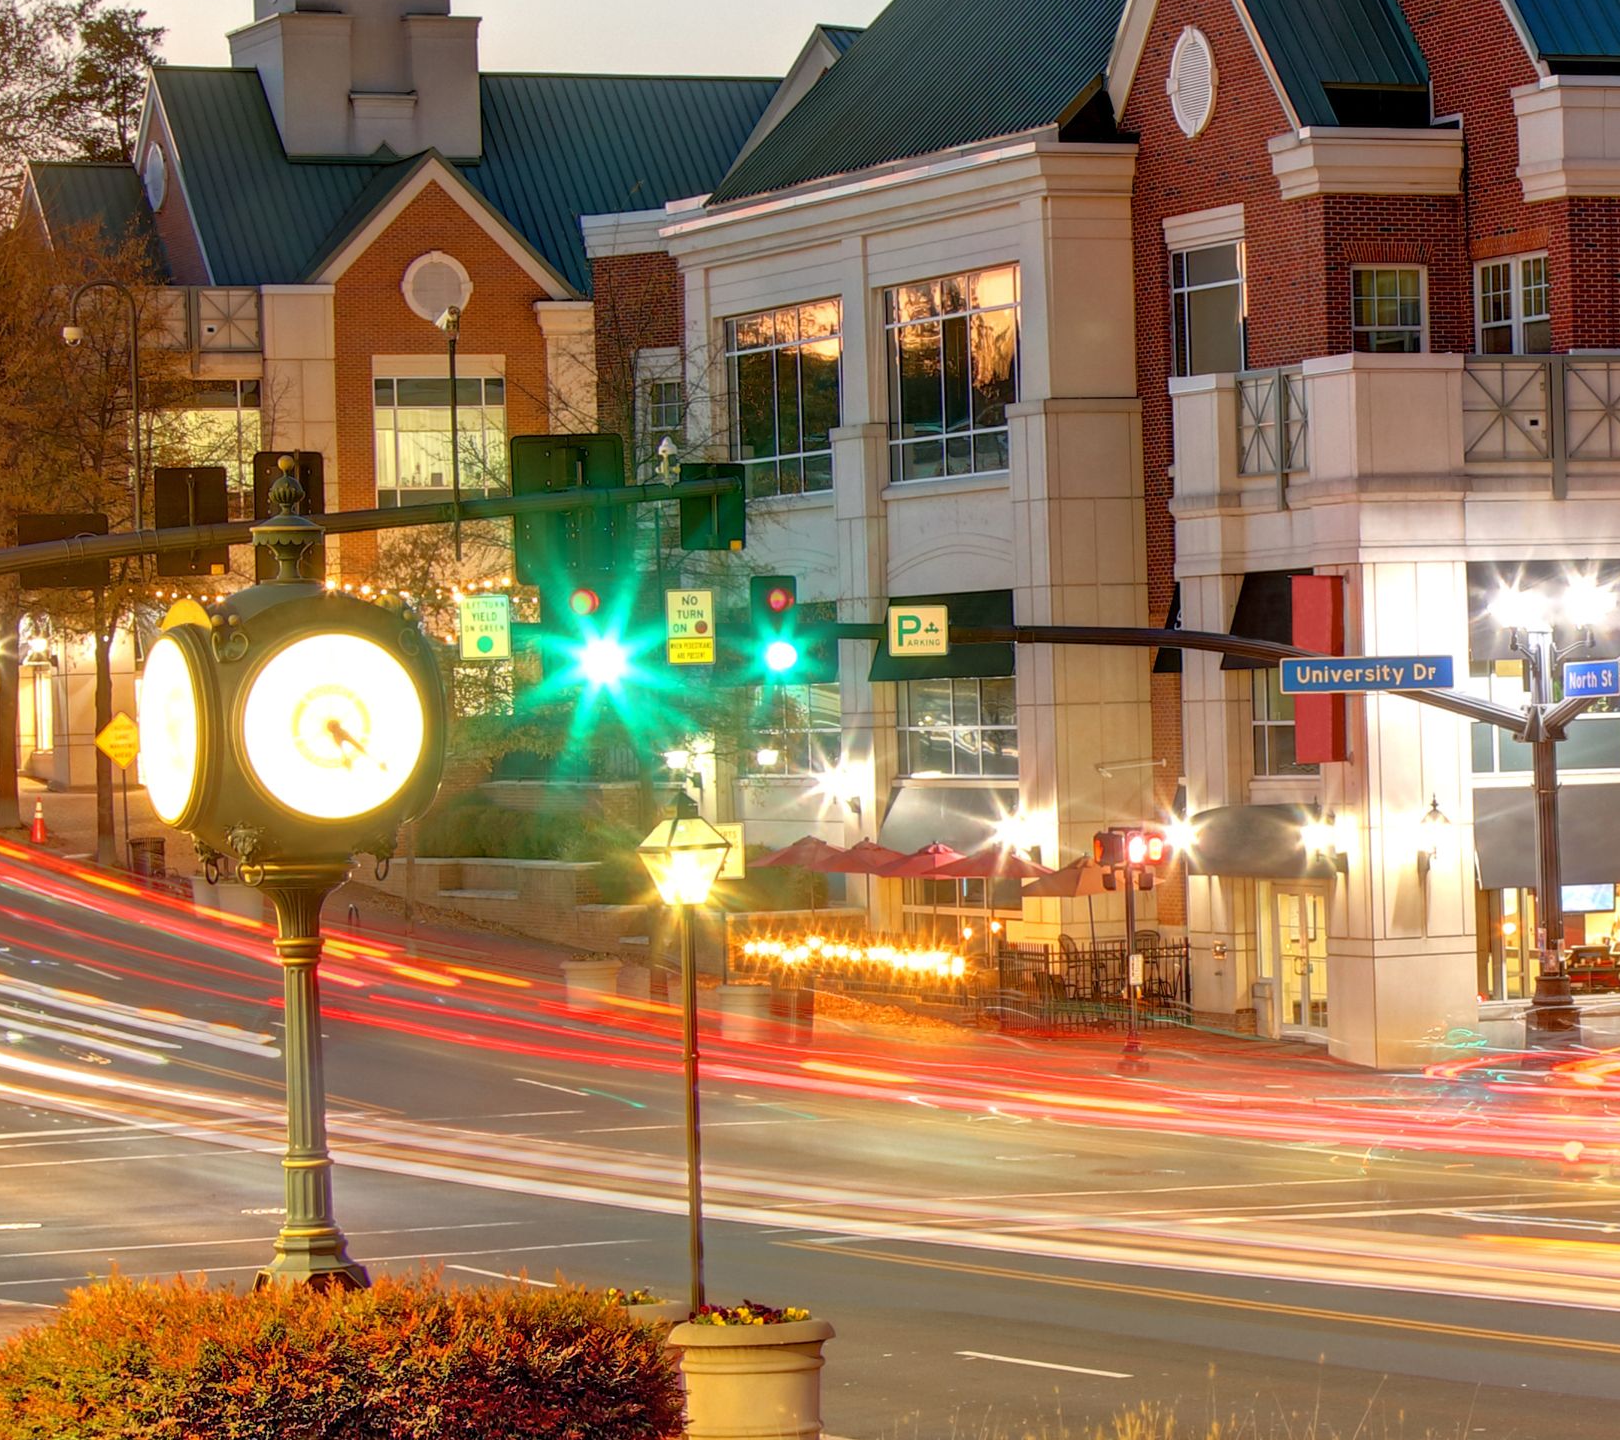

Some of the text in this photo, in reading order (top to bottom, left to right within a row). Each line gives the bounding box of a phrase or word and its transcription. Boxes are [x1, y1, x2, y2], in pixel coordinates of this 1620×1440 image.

[682, 595, 698, 605] NO
[472, 612, 497, 621] YIELD
[677, 610, 703, 619] TURN
[673, 623, 687, 633] ON
[1296, 663, 1436, 685] University Dr
[1569, 669, 1612, 689] North St
